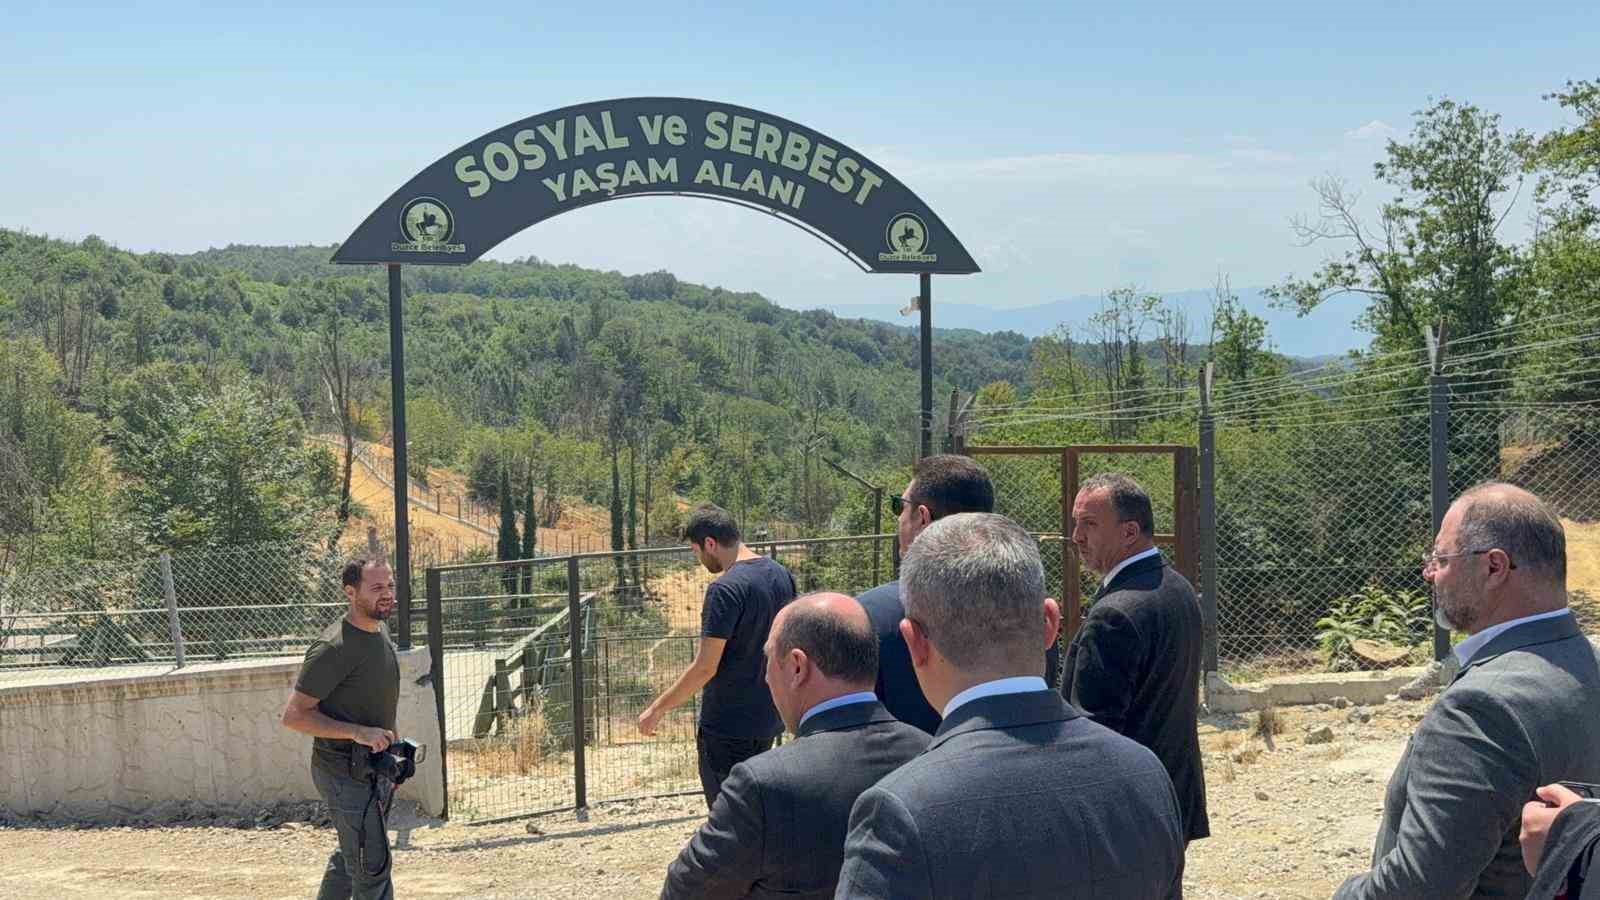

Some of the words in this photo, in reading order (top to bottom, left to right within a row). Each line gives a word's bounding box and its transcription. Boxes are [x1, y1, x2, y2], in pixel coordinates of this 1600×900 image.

[455, 110, 630, 198] SOSYAL
[638, 114, 688, 146] ve
[704, 111, 883, 205] SERBEST
[542, 157, 679, 202] YAŞAM
[693, 159, 806, 209] ALANI
